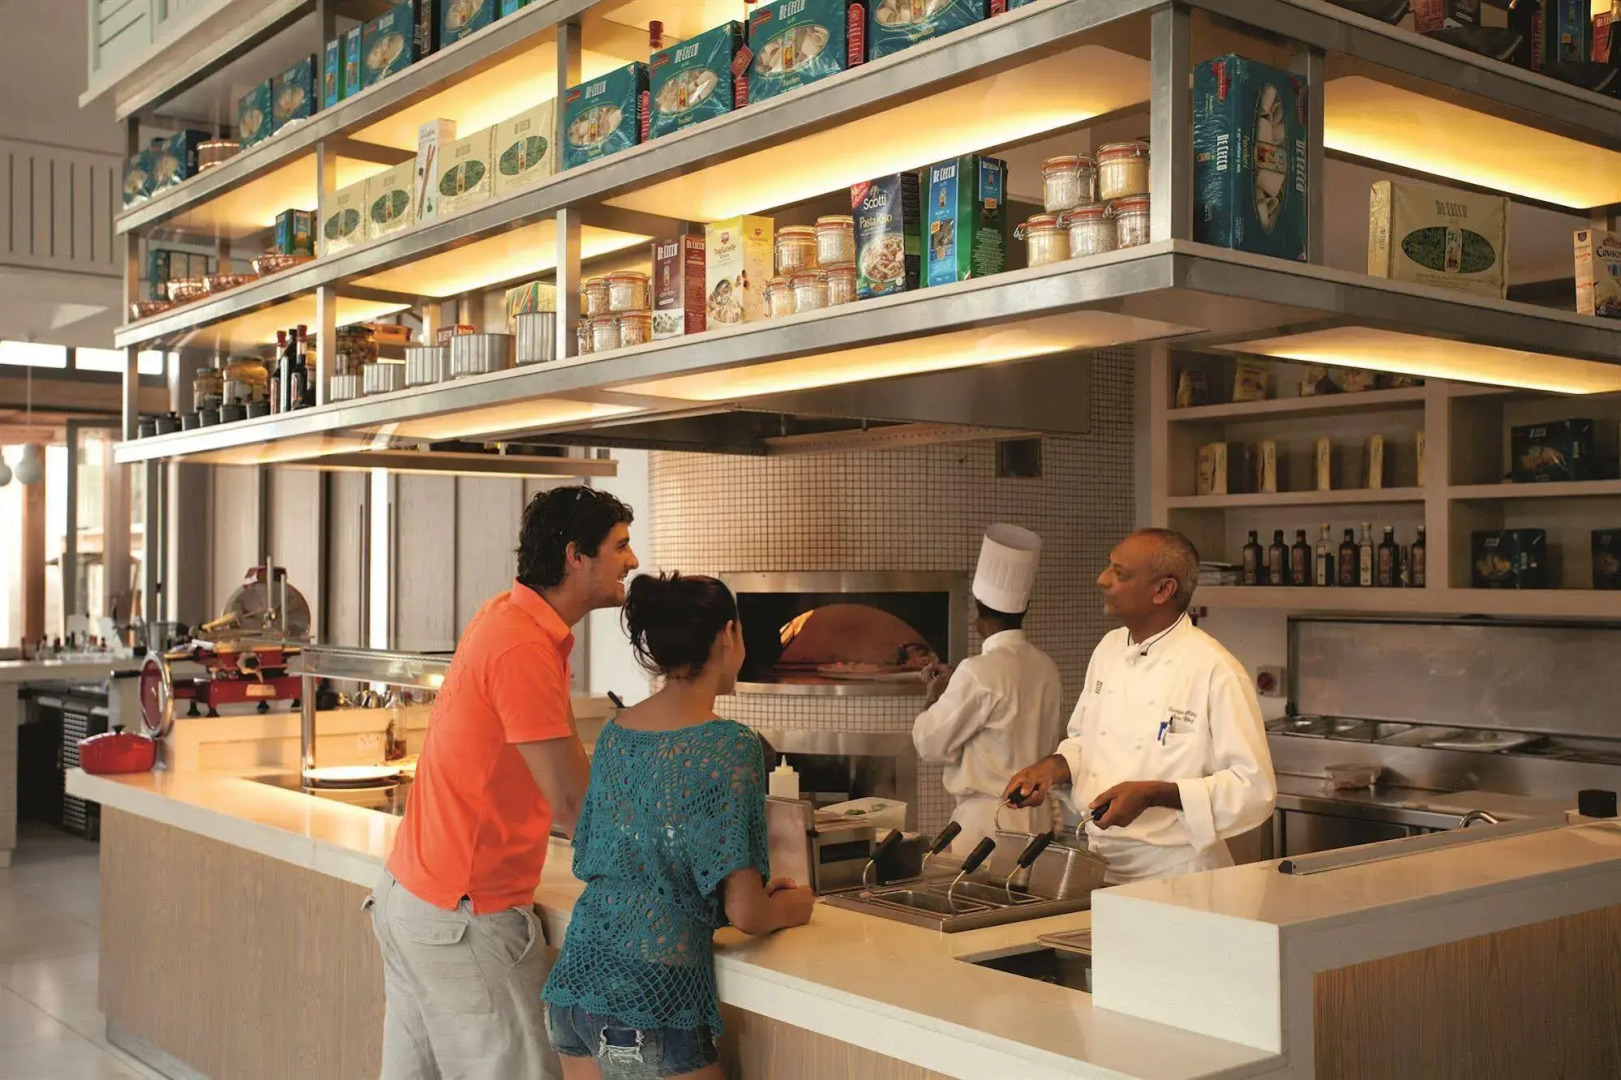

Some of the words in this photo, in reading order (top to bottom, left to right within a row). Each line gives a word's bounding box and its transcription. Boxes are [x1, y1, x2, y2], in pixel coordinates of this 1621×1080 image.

[1217, 134, 1229, 146] DE
[1216, 146, 1229, 171] CECCO
[933, 170, 940, 184] DE
[940, 165, 956, 181] CECCO
[863, 194, 887, 211] Scotti
[658, 246, 664, 261] DE
[664, 243, 679, 259] CECCO
